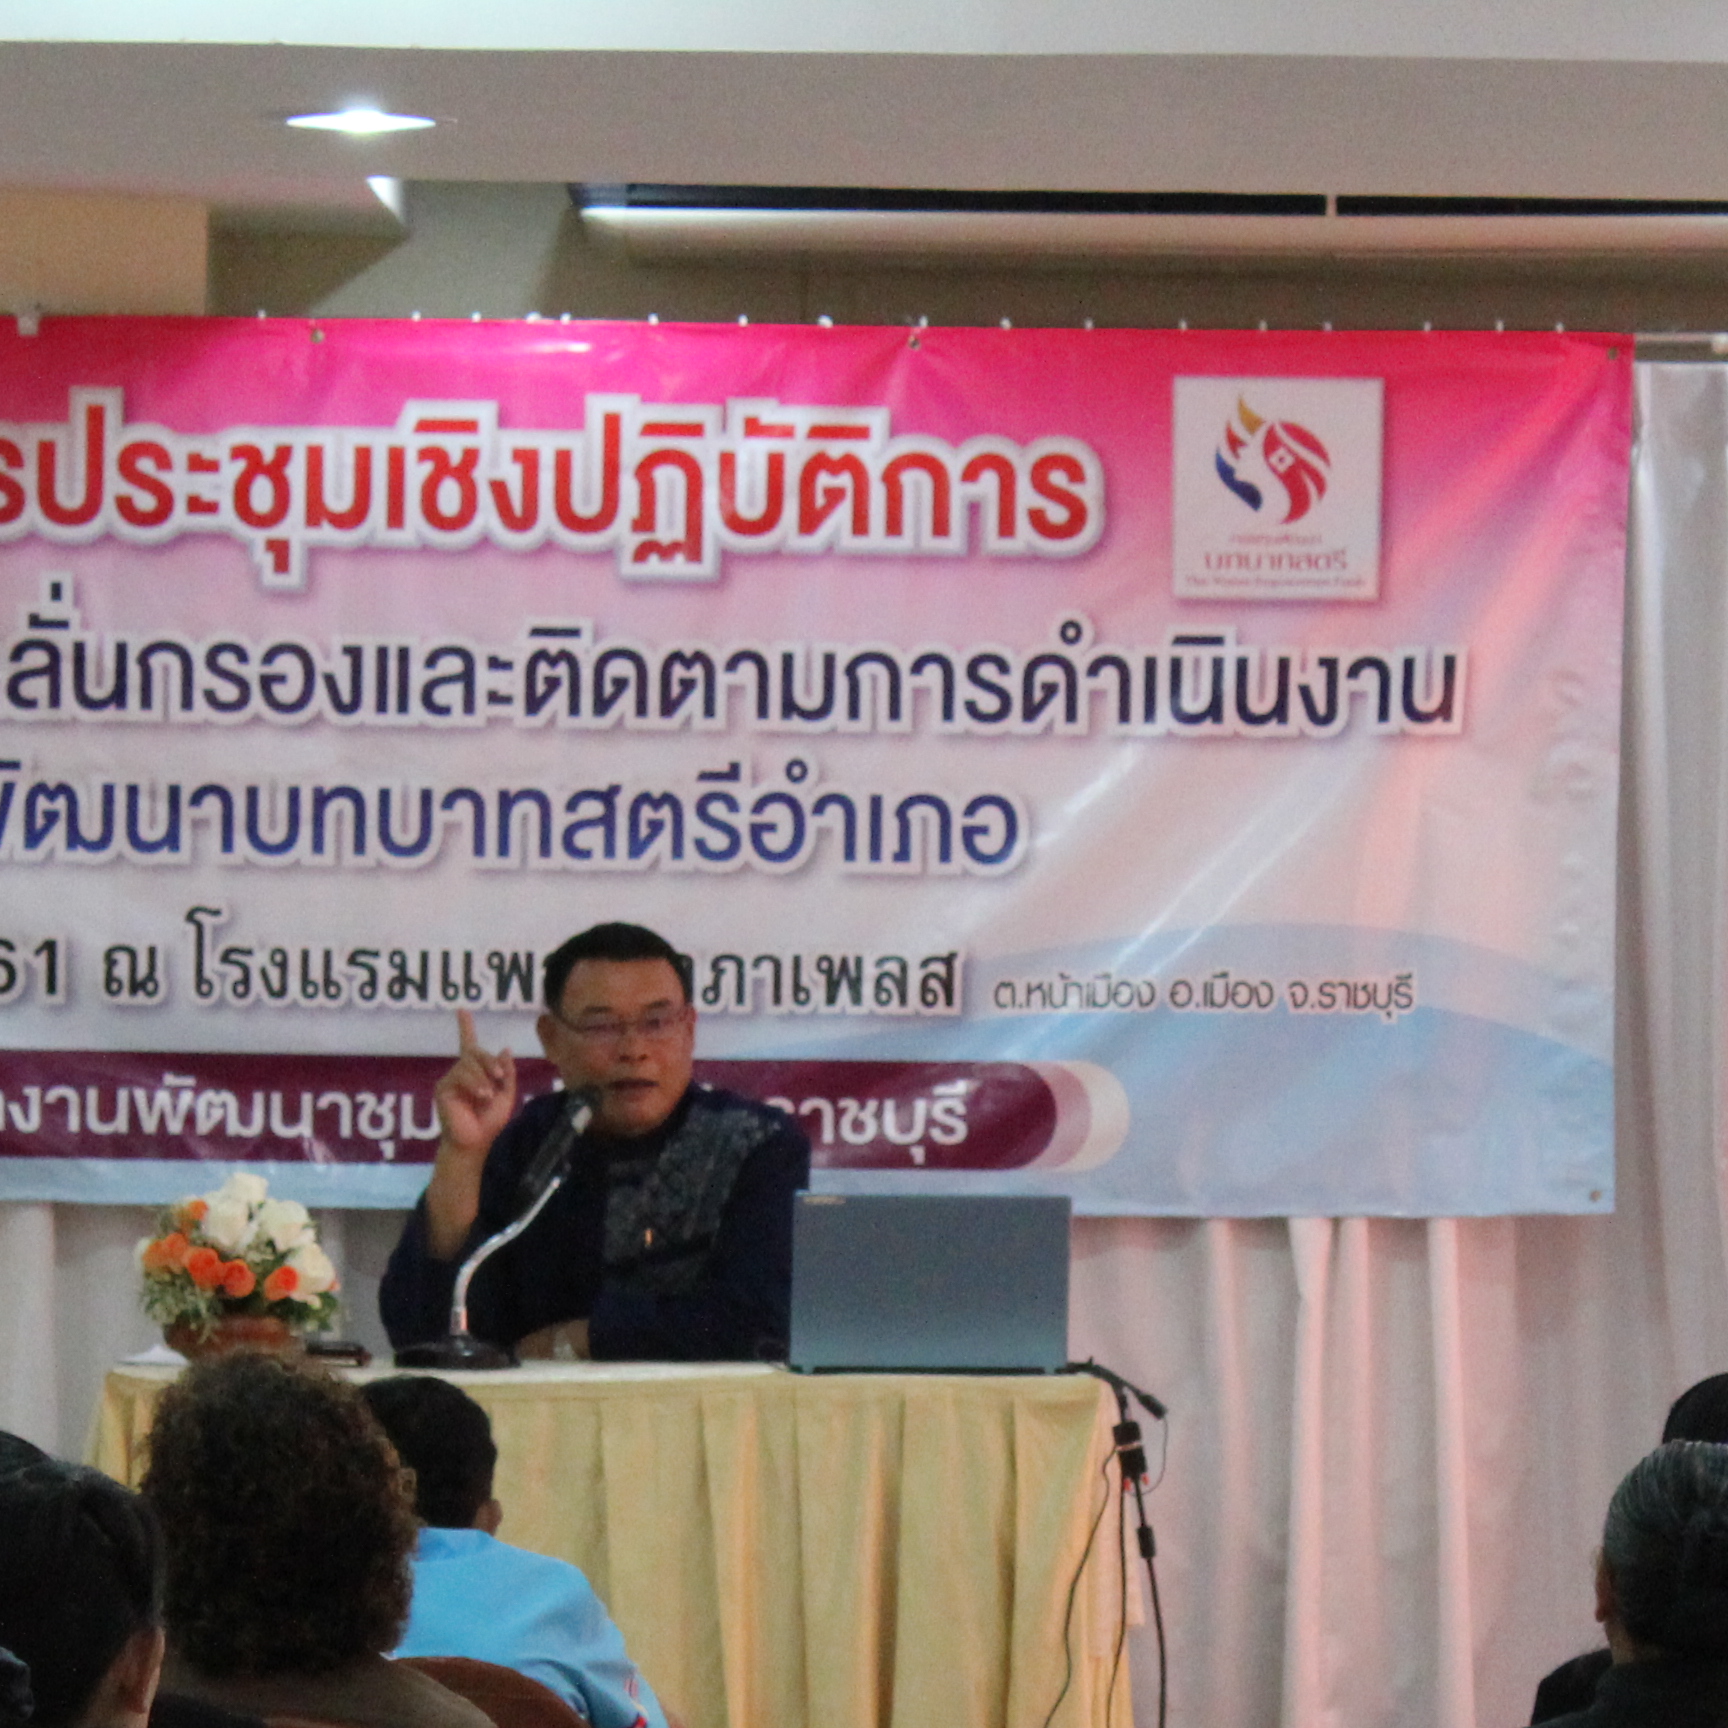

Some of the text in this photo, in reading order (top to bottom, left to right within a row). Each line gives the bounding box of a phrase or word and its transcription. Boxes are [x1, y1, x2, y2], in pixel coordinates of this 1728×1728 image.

[103, 944, 161, 999] ณ
[993, 972, 1157, 1009] ต.หน้าเมือง
[1169, 971, 1273, 1009] อ.เมือง
[1288, 973, 1415, 1018] จ.ราชบุรี
